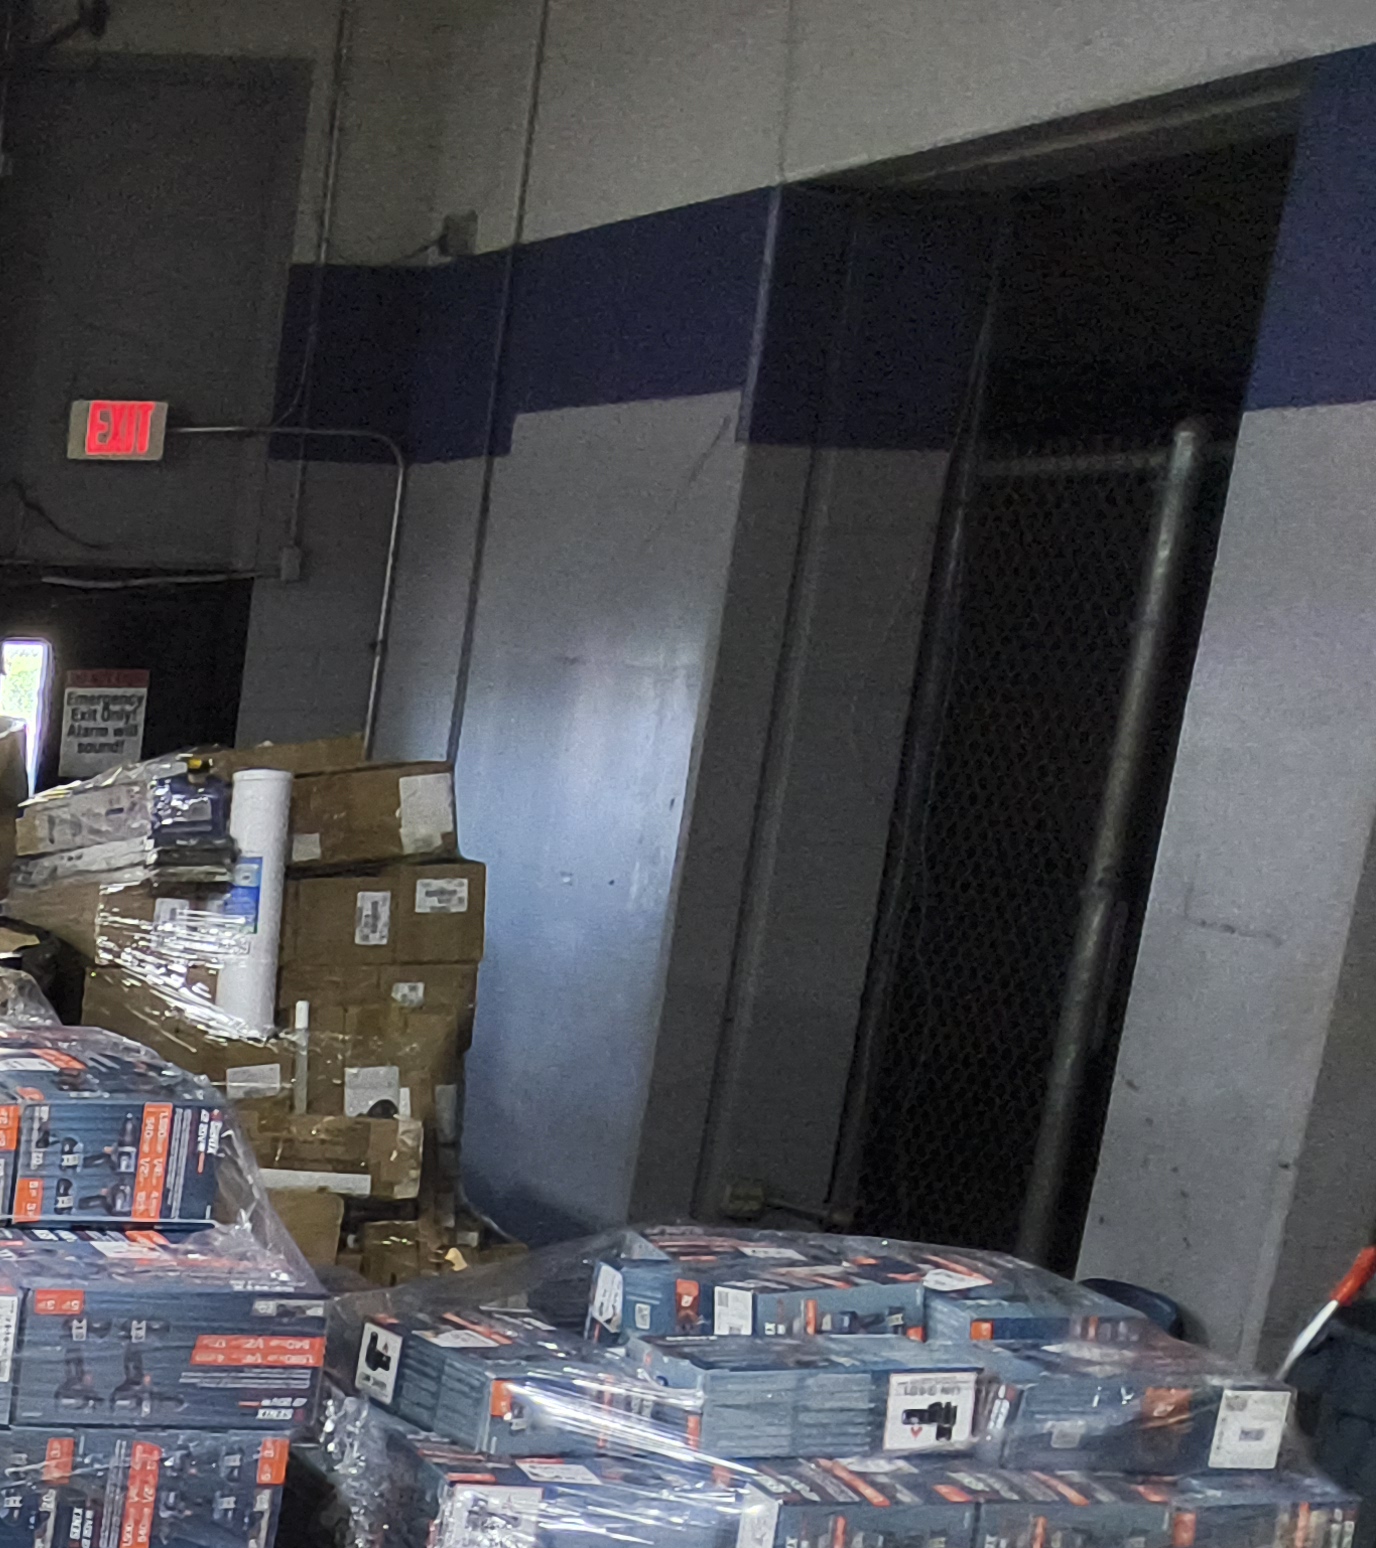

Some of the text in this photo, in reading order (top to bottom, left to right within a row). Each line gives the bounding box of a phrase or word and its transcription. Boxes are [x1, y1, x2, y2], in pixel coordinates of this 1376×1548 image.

[86, 400, 156, 455] EXIT
[67, 692, 145, 718] Emergency
[71, 708, 97, 722] Exit
[67, 724, 108, 738] Alarm
